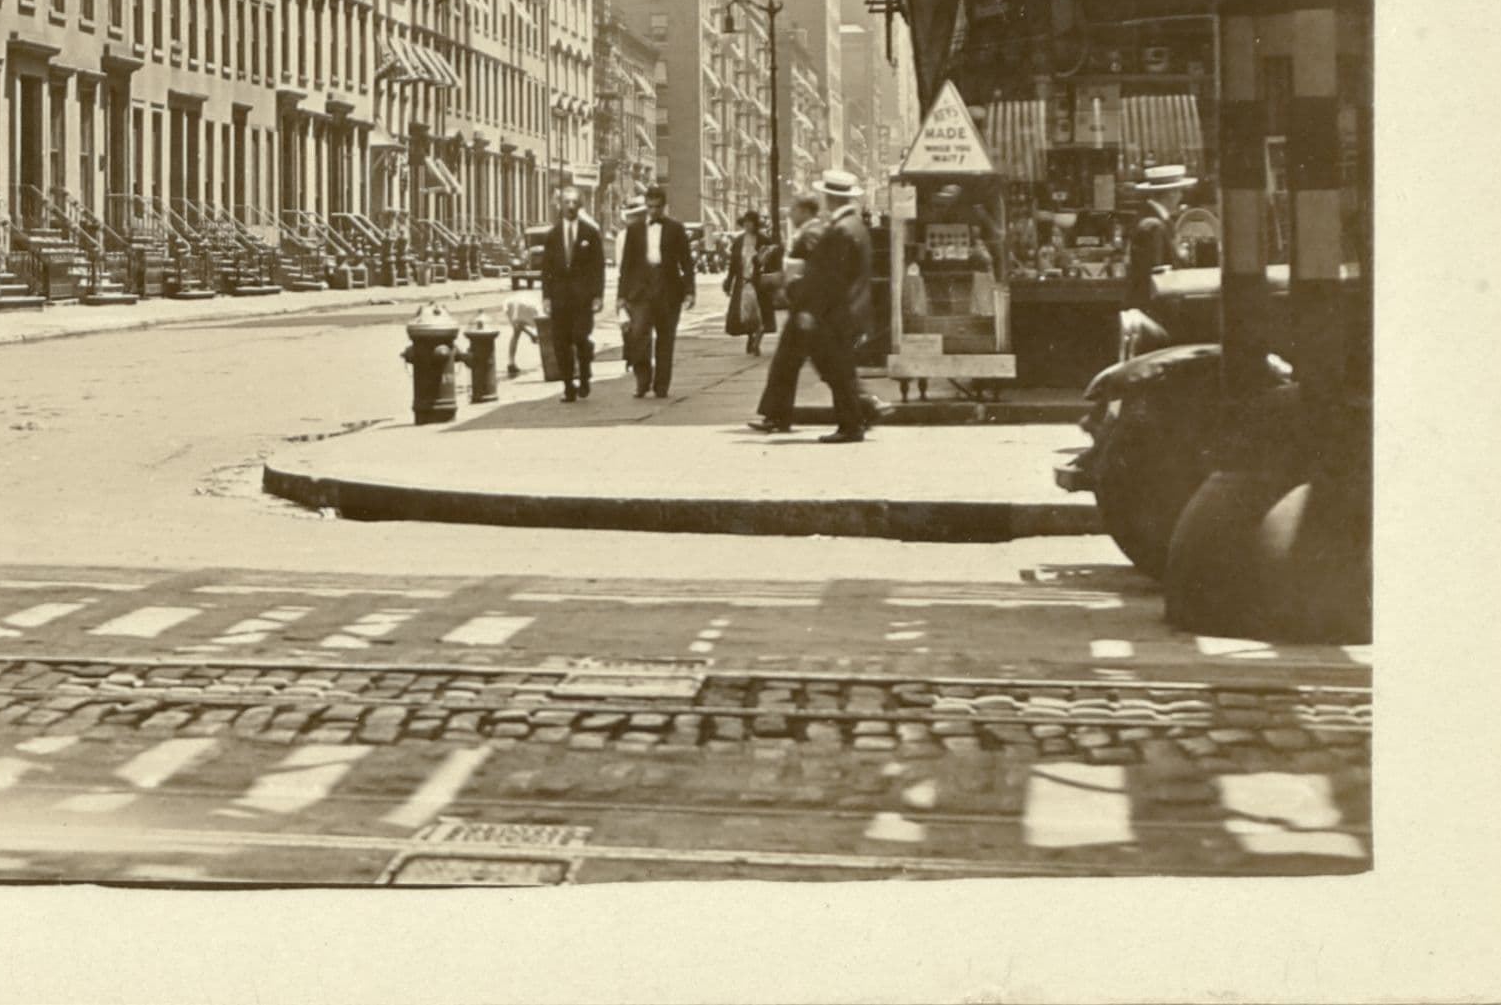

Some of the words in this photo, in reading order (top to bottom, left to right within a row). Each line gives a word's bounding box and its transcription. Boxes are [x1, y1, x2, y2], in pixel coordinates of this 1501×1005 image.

[924, 127, 967, 139] MADE
[924, 145, 951, 153] WHILE
[953, 145, 971, 153] YOU
